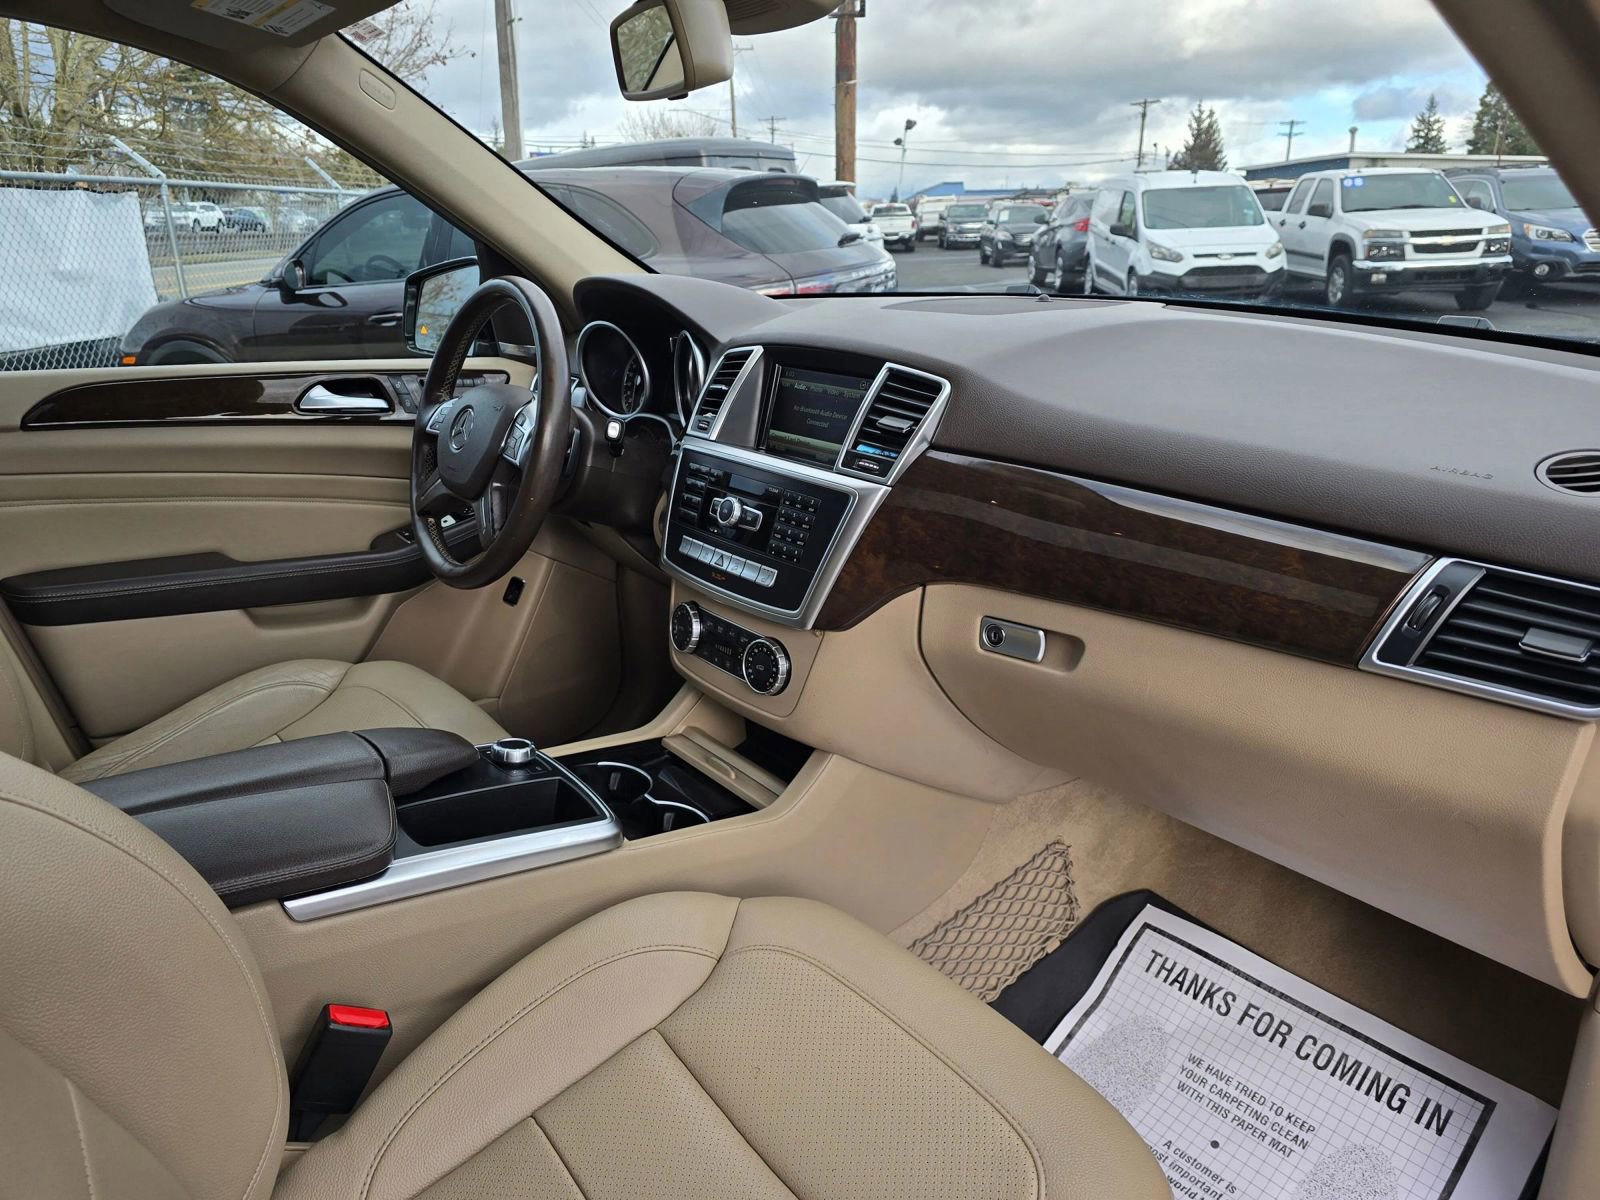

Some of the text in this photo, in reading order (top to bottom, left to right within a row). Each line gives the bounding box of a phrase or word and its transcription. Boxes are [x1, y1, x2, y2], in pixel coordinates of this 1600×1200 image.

[1145, 949, 1453, 1137] THANKS FOR COMING IN
[1177, 1080, 1296, 1159] WITH THIS PAPER MAT
[1179, 1065, 1310, 1150] YOUR CARPETING CLEAN
[1187, 1053, 1316, 1134] WE HAVE TRIED TO KEEP
[1163, 1140, 1238, 1194] A customer is
[1168, 1160, 1224, 1200] important
